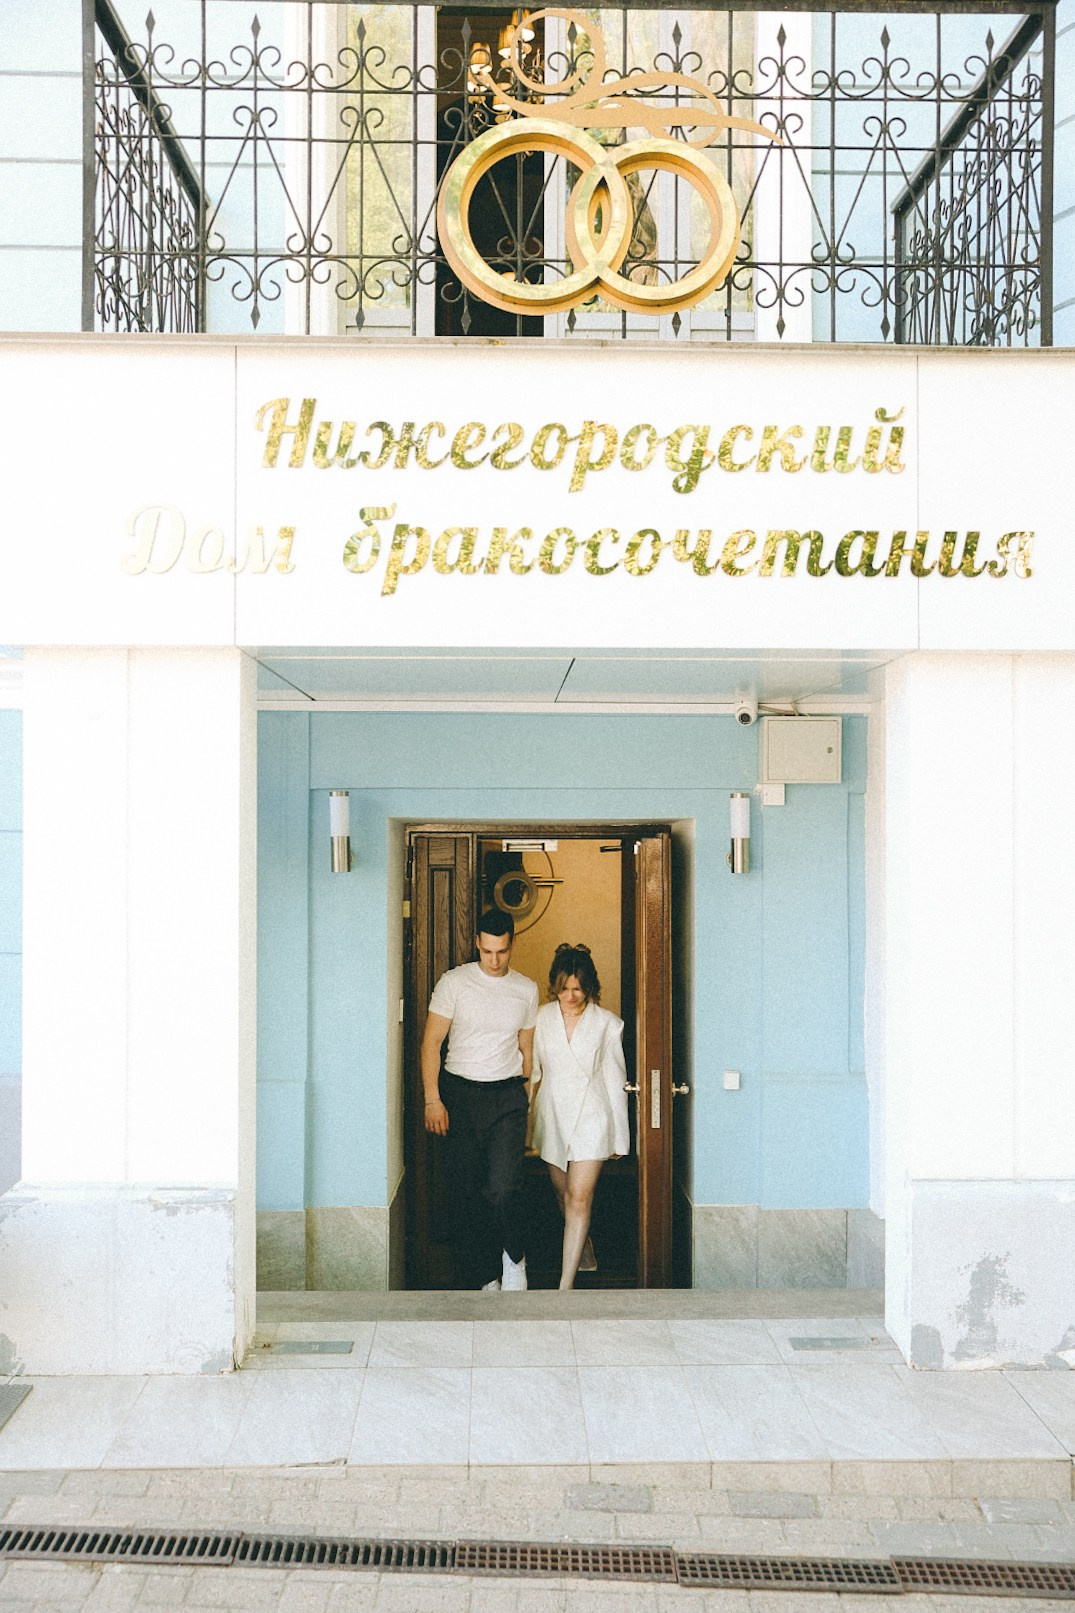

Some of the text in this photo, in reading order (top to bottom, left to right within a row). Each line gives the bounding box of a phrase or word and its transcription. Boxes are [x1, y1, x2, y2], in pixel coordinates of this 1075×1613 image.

[254, 397, 907, 494] Нижегородский
[121, 502, 1036, 597] Дом бракосочетания
